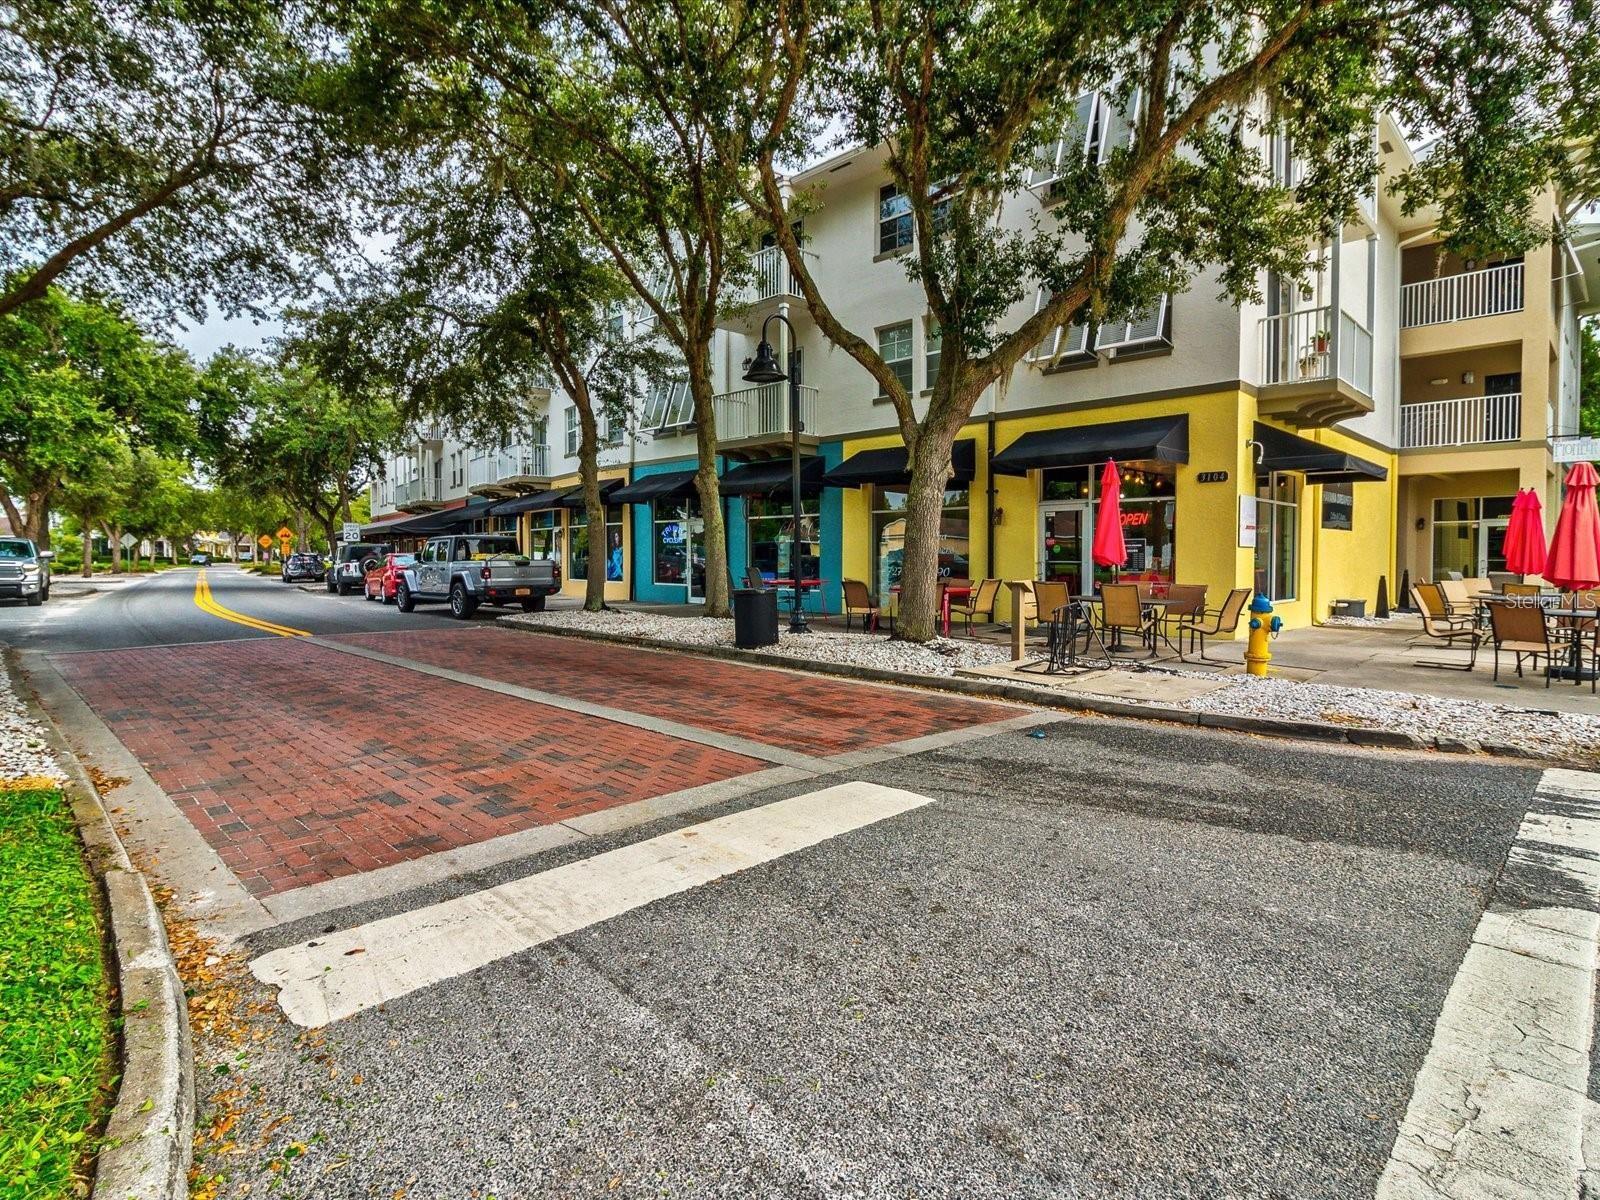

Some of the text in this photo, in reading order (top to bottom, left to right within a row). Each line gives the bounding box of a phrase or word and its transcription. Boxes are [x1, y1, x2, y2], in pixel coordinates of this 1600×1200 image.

[1201, 473, 1225, 482] 3104
[1120, 513, 1148, 526] OPEN
[345, 532, 358, 540] 20
